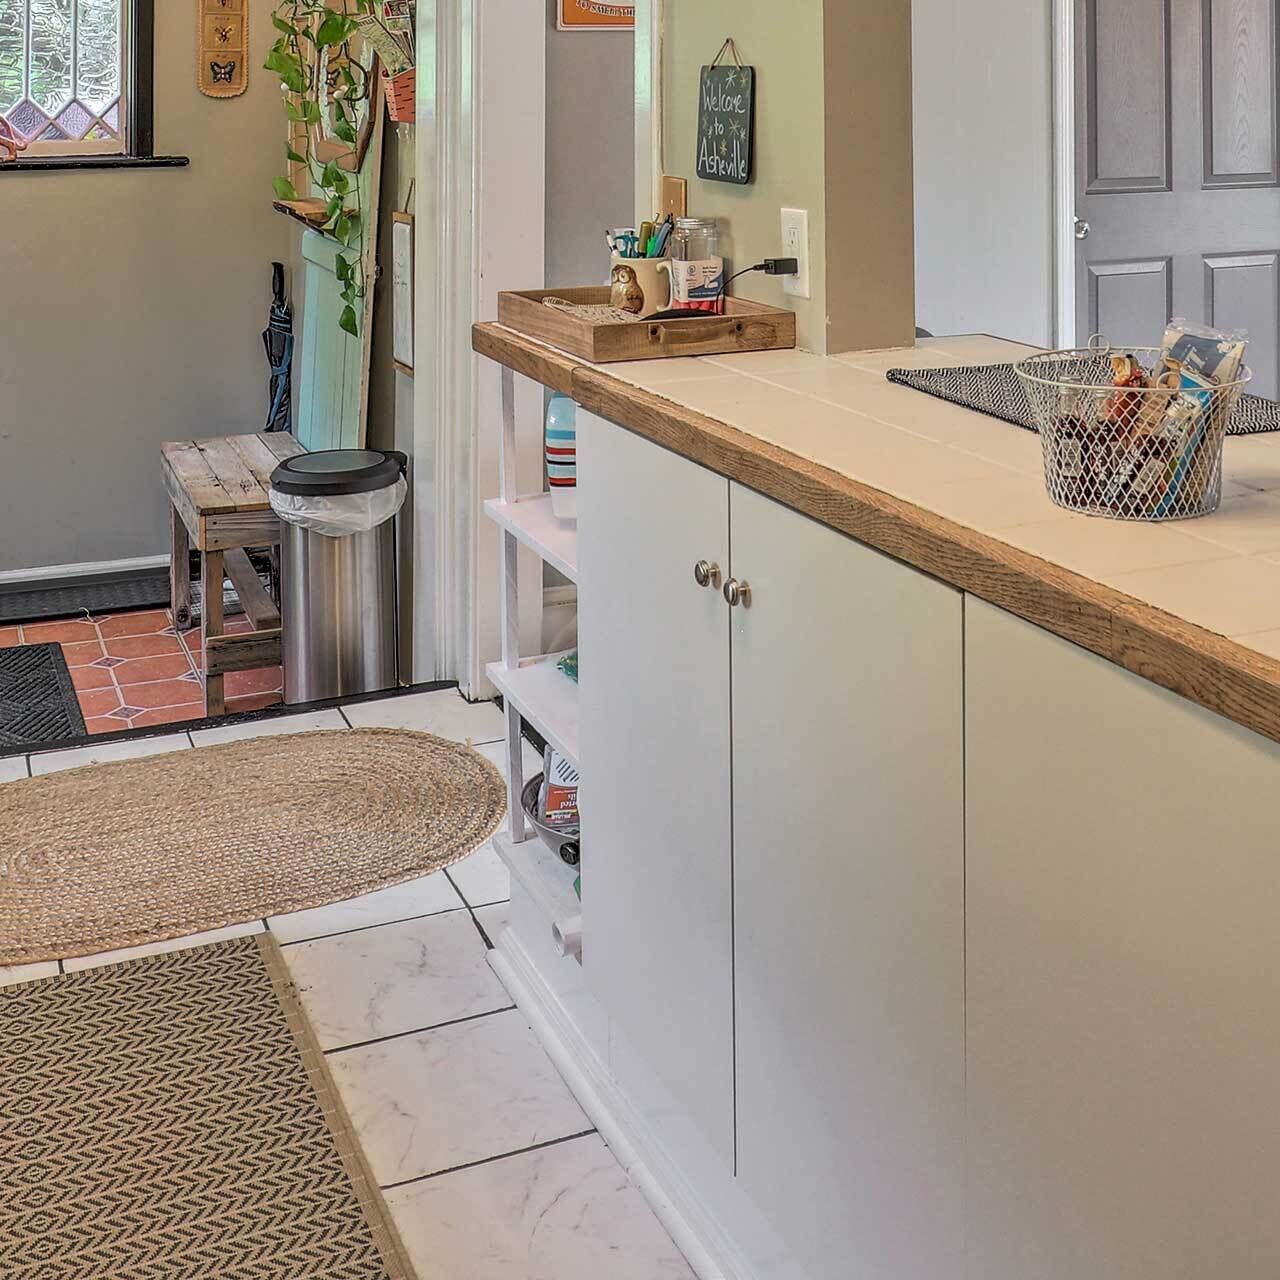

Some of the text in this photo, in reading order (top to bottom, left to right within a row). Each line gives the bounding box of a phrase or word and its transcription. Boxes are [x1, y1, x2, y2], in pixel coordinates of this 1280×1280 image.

[702, 82, 746, 114] Welcome
[713, 116, 725, 136] to
[697, 136, 746, 180] Asheville
